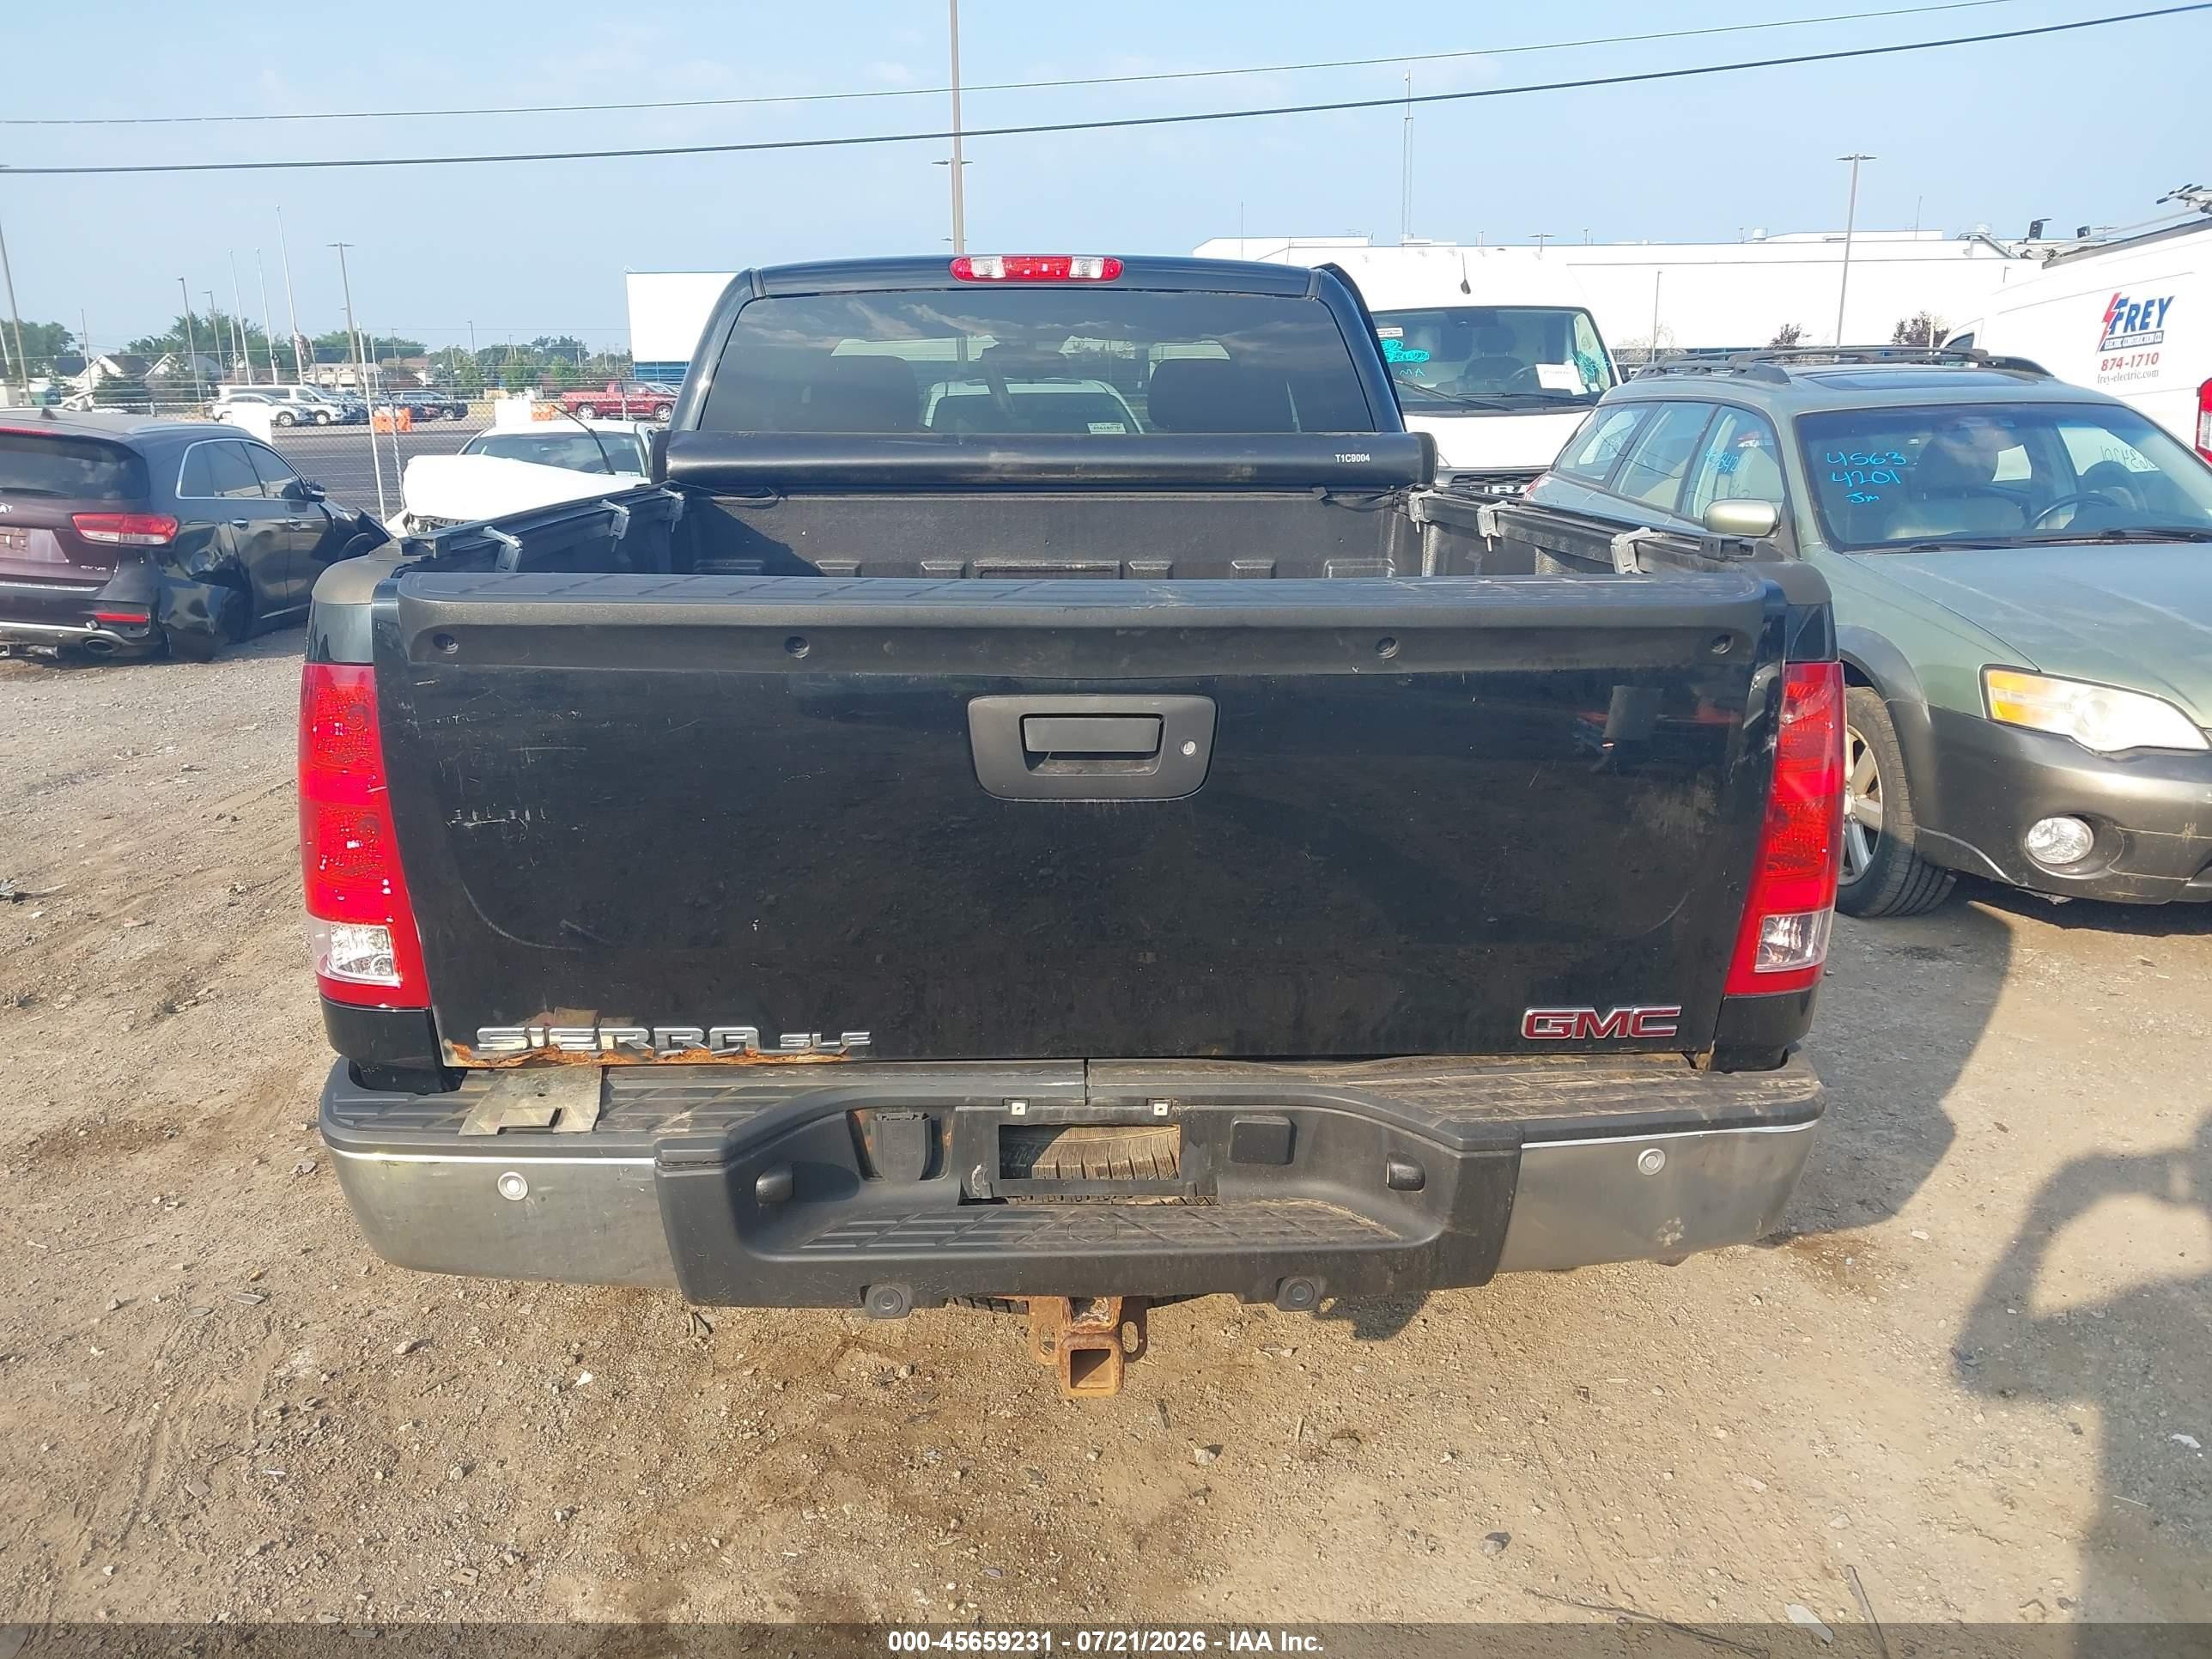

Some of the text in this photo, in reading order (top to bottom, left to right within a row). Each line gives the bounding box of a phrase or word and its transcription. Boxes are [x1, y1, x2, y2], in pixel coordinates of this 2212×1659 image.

[2109, 296, 2175, 336] FREY
[2101, 352, 2160, 371] 874-1710
[2097, 370, 2160, 385] frey-electric.com
[1335, 453, 1370, 463] T1C9004
[1827, 452, 1906, 466] 4563
[1832, 470, 1901, 488] 4201
[1521, 1005, 1682, 1040] GMC
[477, 1026, 871, 1050] SIERRA SLE
